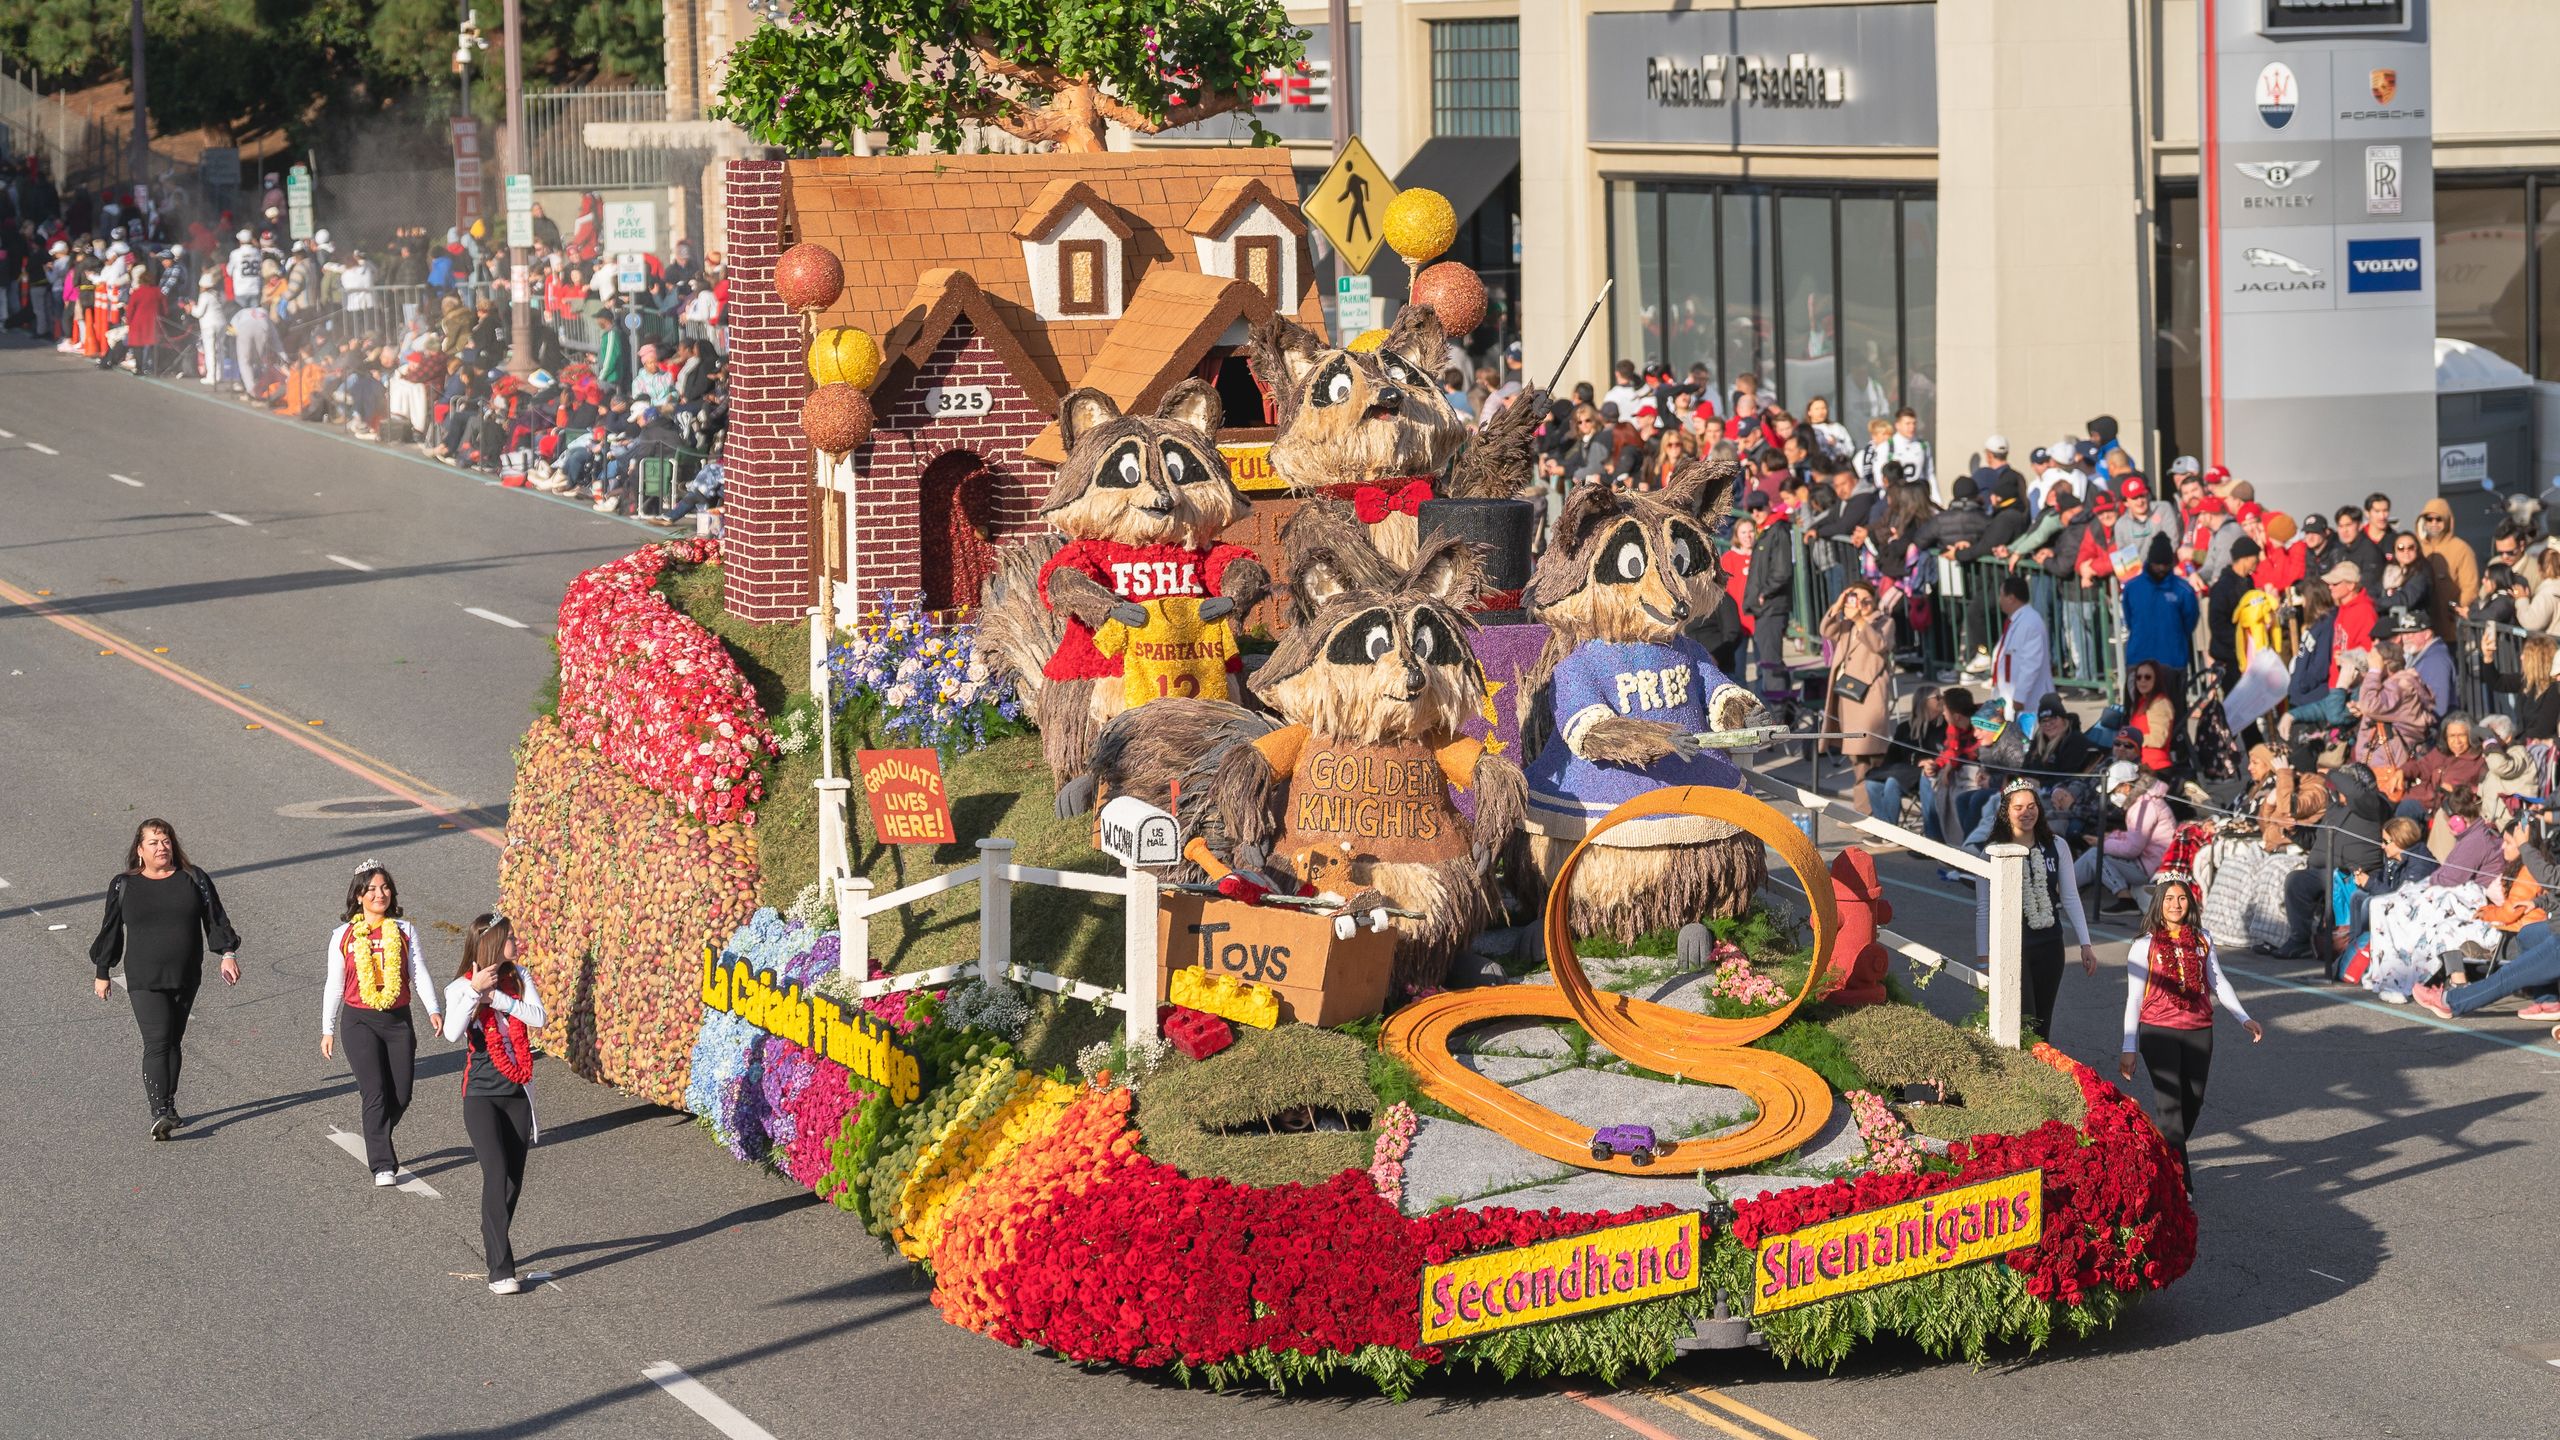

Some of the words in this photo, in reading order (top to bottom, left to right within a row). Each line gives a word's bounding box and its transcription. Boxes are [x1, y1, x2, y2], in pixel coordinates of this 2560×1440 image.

[1737, 53, 1842, 101] Pasadena
[2340, 109, 2425, 120] PORSCHE
[2244, 194, 2315, 208] BENTLEY
[614, 228, 646, 238] HERE
[618, 218, 641, 227] PAY
[2353, 258, 2418, 273] VOLVO
[2234, 280, 2326, 292] JAGUAR
[1340, 294, 1370, 305] PARKING
[938, 393, 984, 410] 325
[1111, 561, 1203, 596] FSHA
[1135, 641, 1224, 661] SPARTANS
[1156, 673, 1201, 699] 12
[1615, 664, 1691, 714] PREP
[864, 758, 940, 796] GRADUATE
[1310, 751, 1439, 797] GOLDEN
[884, 792, 928, 812] LIVES
[883, 807, 945, 838] HERE!
[1298, 793, 1438, 840] KNIGHTS
[1146, 837, 1167, 848] MAIL
[1151, 827, 1164, 838] US
[1187, 921, 1291, 982] Toys
[702, 944, 730, 1013] La
[812, 993, 922, 1108] Flintridge
[1763, 1190, 2031, 1298] Shenanigans
[1432, 1225, 1691, 1329] Secondhand
